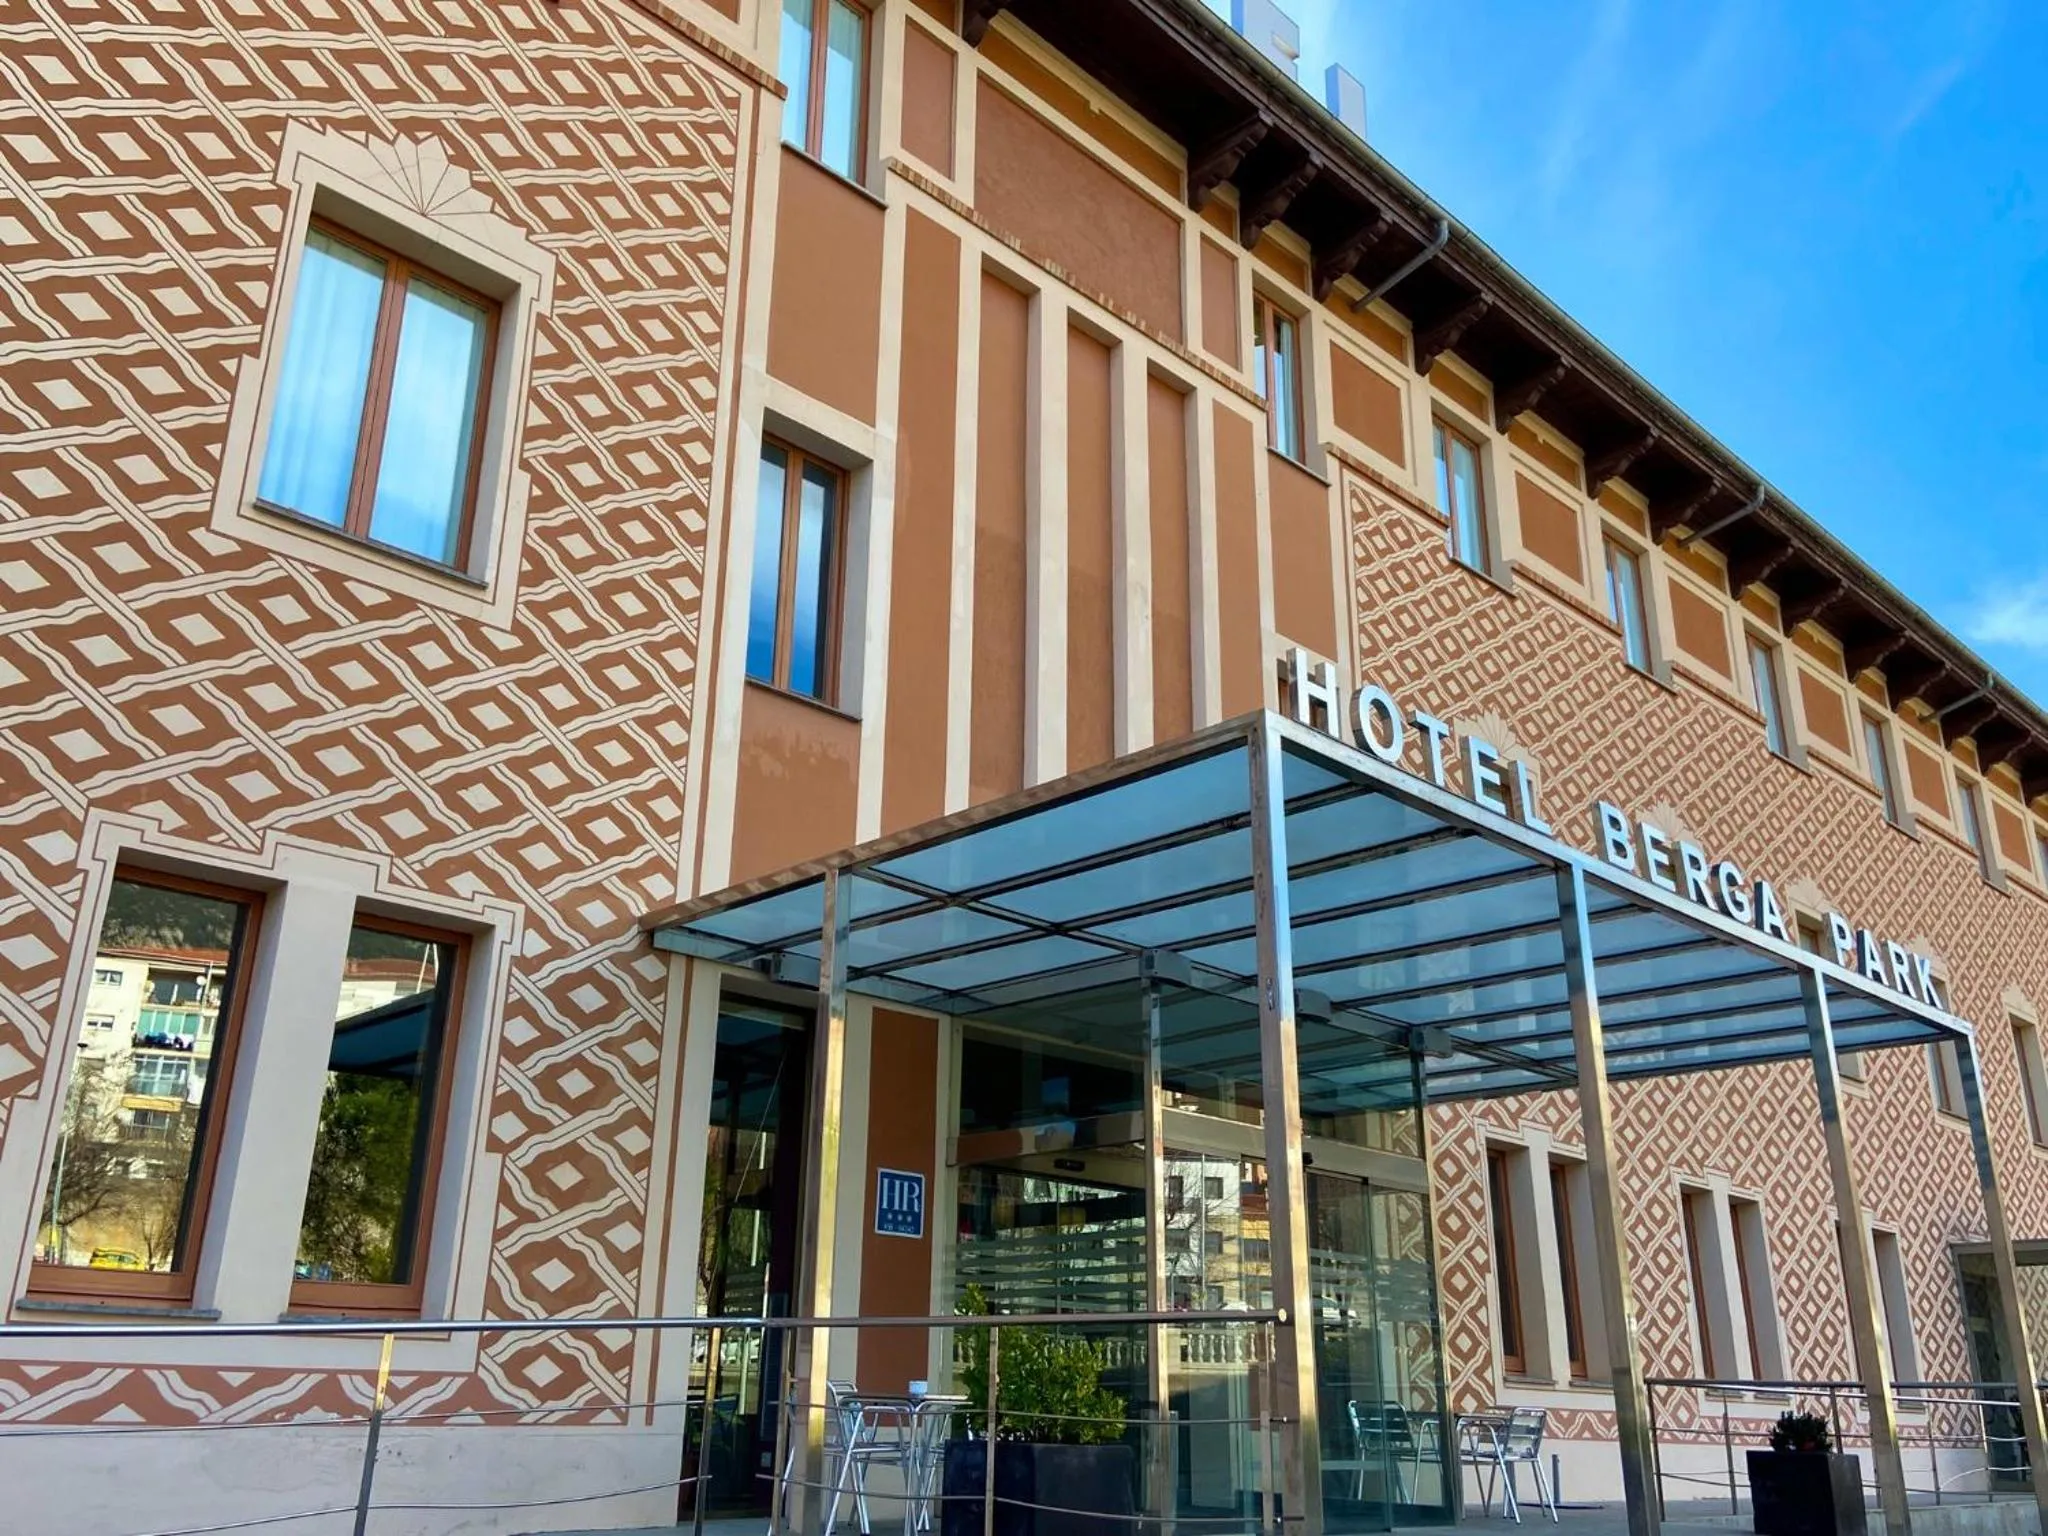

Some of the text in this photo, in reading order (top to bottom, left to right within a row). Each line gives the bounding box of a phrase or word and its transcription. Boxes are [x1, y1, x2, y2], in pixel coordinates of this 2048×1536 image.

[1286, 647, 1945, 1011] HOTEL BERGA PARK
[881, 1178, 920, 1213] HR
